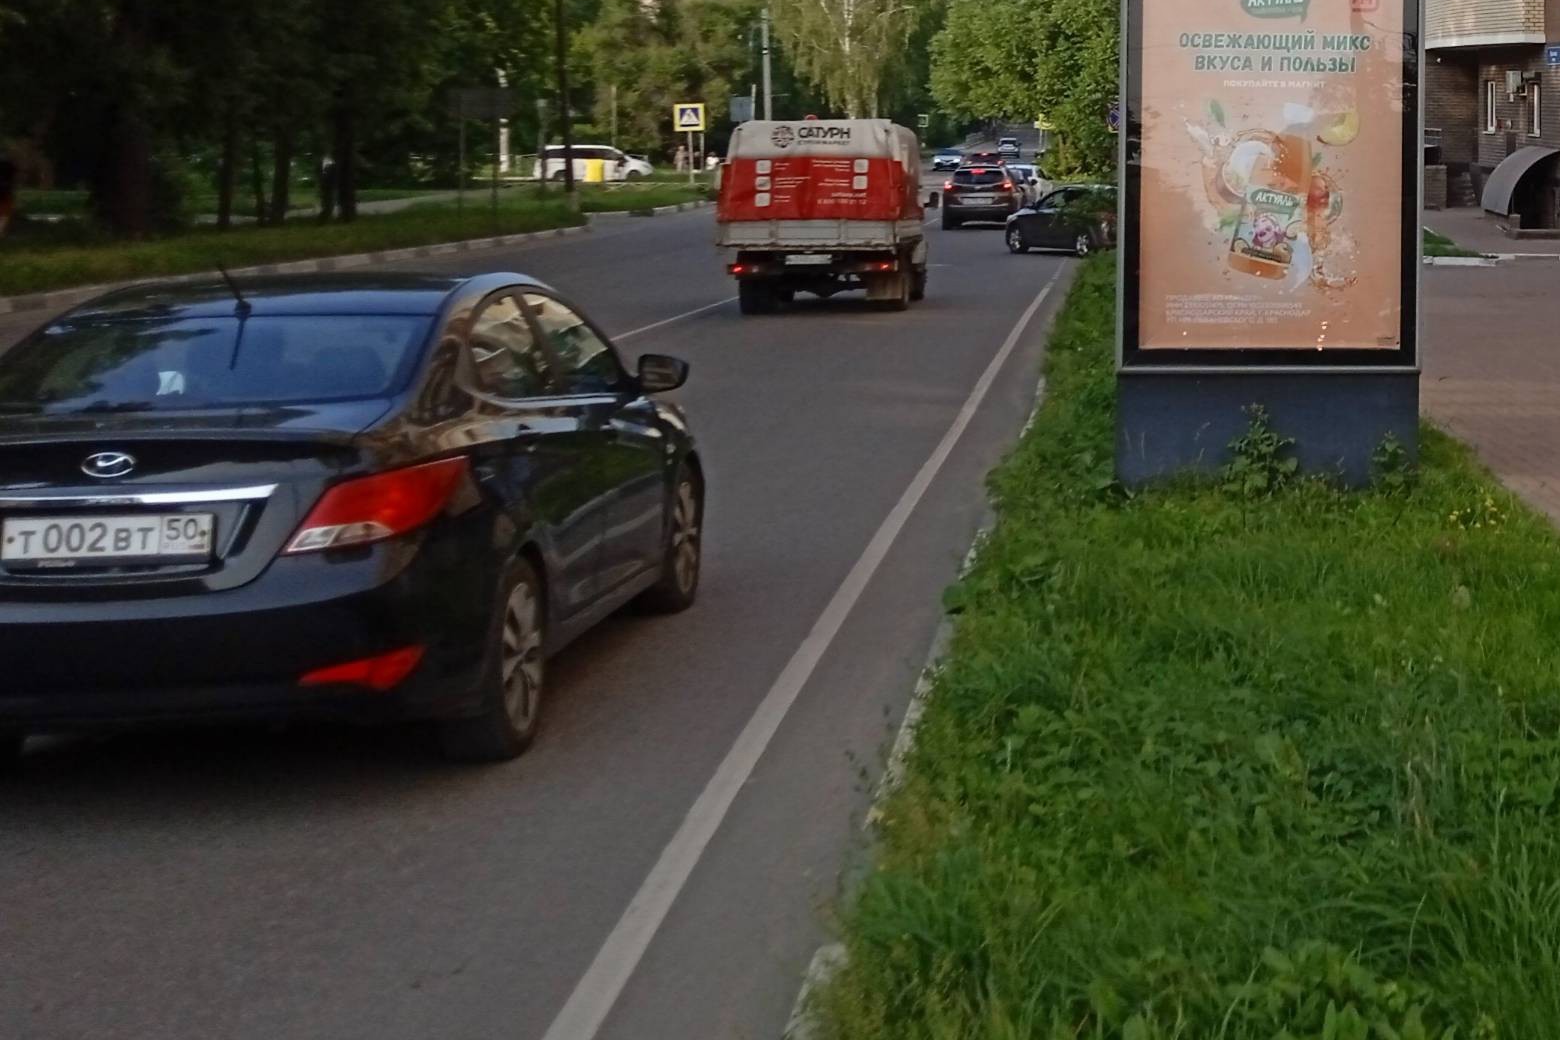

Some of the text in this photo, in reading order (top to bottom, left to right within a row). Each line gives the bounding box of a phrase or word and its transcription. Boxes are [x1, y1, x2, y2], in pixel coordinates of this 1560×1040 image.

[1179, 30, 1371, 52] ОСВЕЖАЮЩИЙ МИКС
[1194, 55, 1356, 73] ВКУСА И ПОЛЬЗЫ
[798, 127, 851, 139] САТУРН
[166, 518, 198, 541] 50
